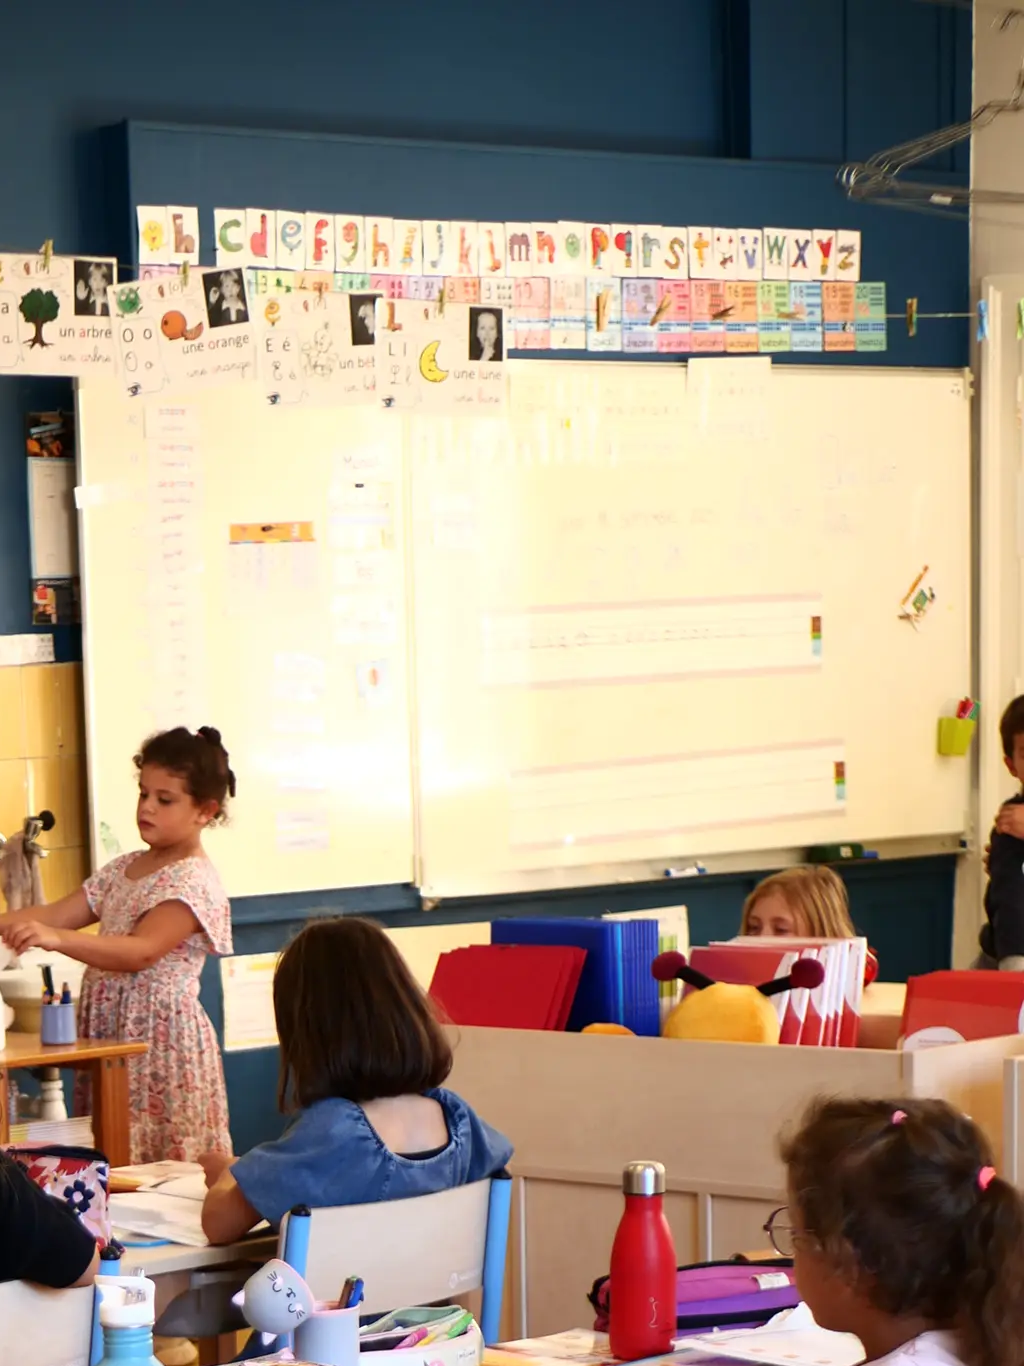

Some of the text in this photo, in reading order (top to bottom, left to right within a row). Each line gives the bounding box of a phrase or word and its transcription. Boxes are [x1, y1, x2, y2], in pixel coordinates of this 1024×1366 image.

[1, 301, 9, 314] a
[59, 324, 112, 339] un arbre
[122, 328, 135, 342] O
[182, 332, 250, 355] une orange
[266, 338, 273, 352] E
[389, 342, 395, 356] L
[339, 359, 354, 370] un
[453, 366, 502, 381] une lune
